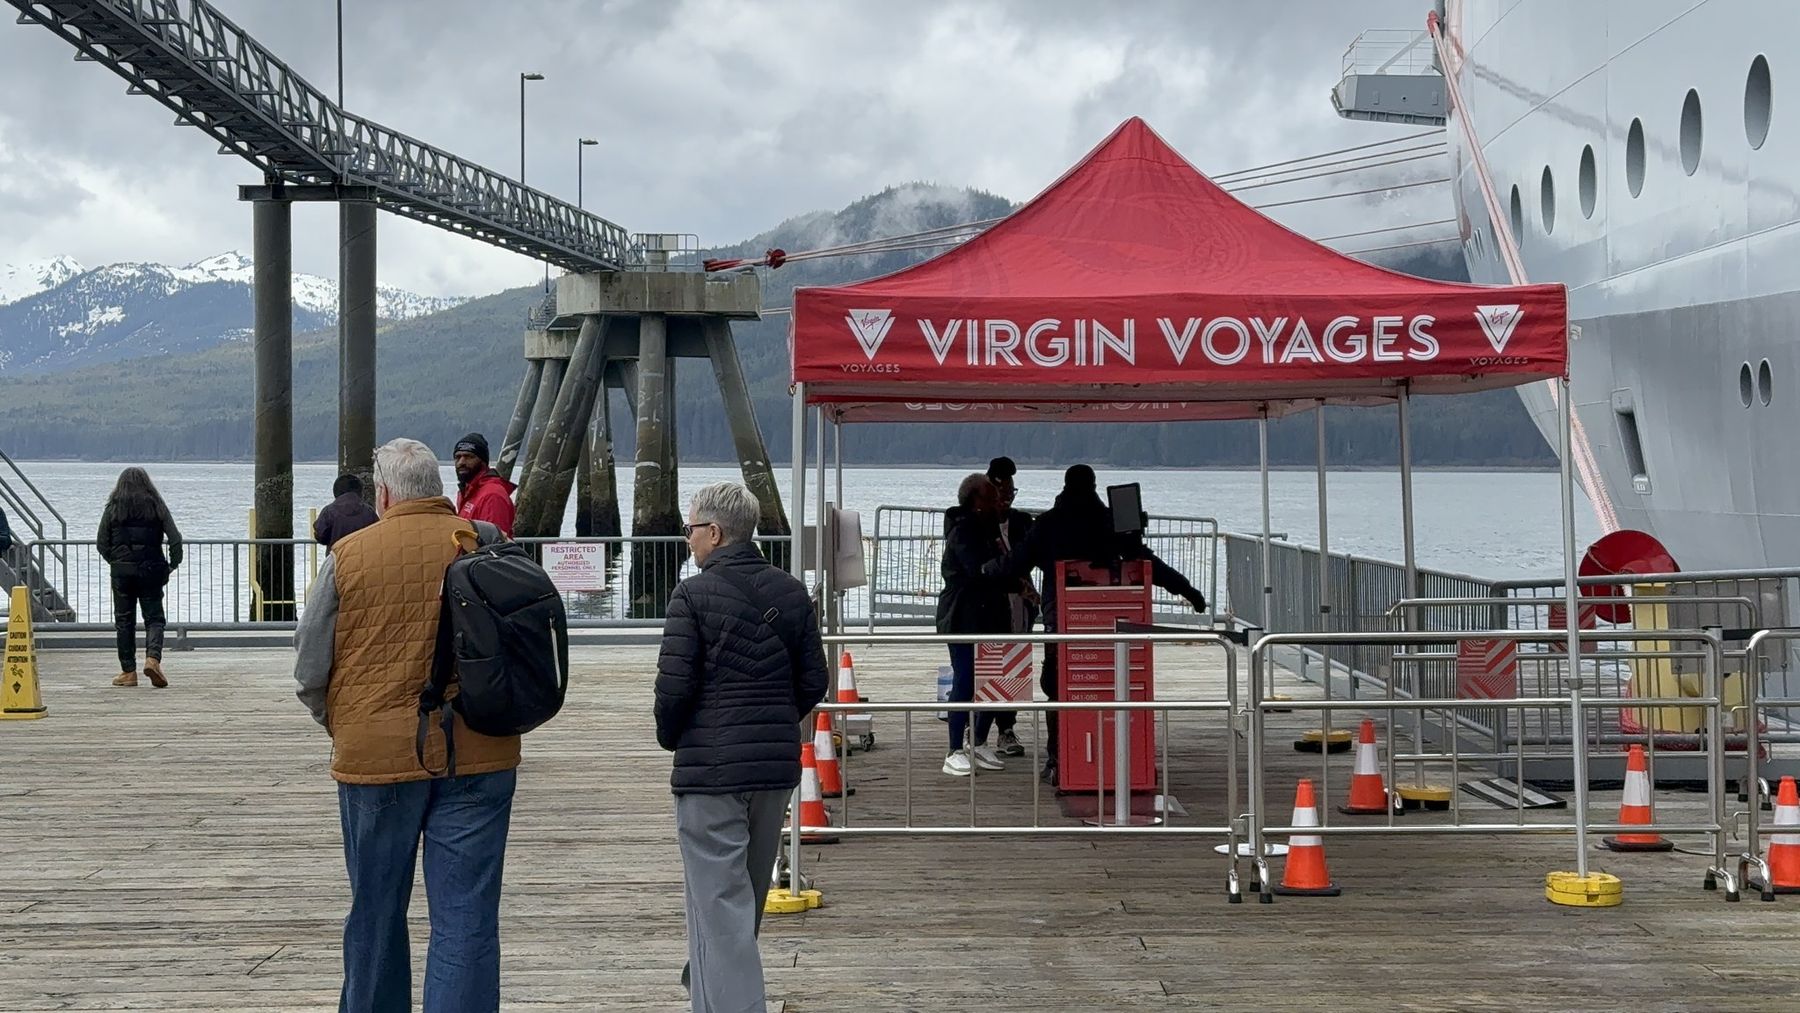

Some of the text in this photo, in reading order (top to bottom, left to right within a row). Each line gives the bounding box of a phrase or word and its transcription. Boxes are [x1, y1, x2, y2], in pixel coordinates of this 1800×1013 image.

[917, 314, 1440, 367] VIRGIN VOYAGES
[1470, 356, 1529, 366] VOYAGES
[841, 363, 901, 373] VOYAGES
[1071, 653, 1098, 661] 021-030
